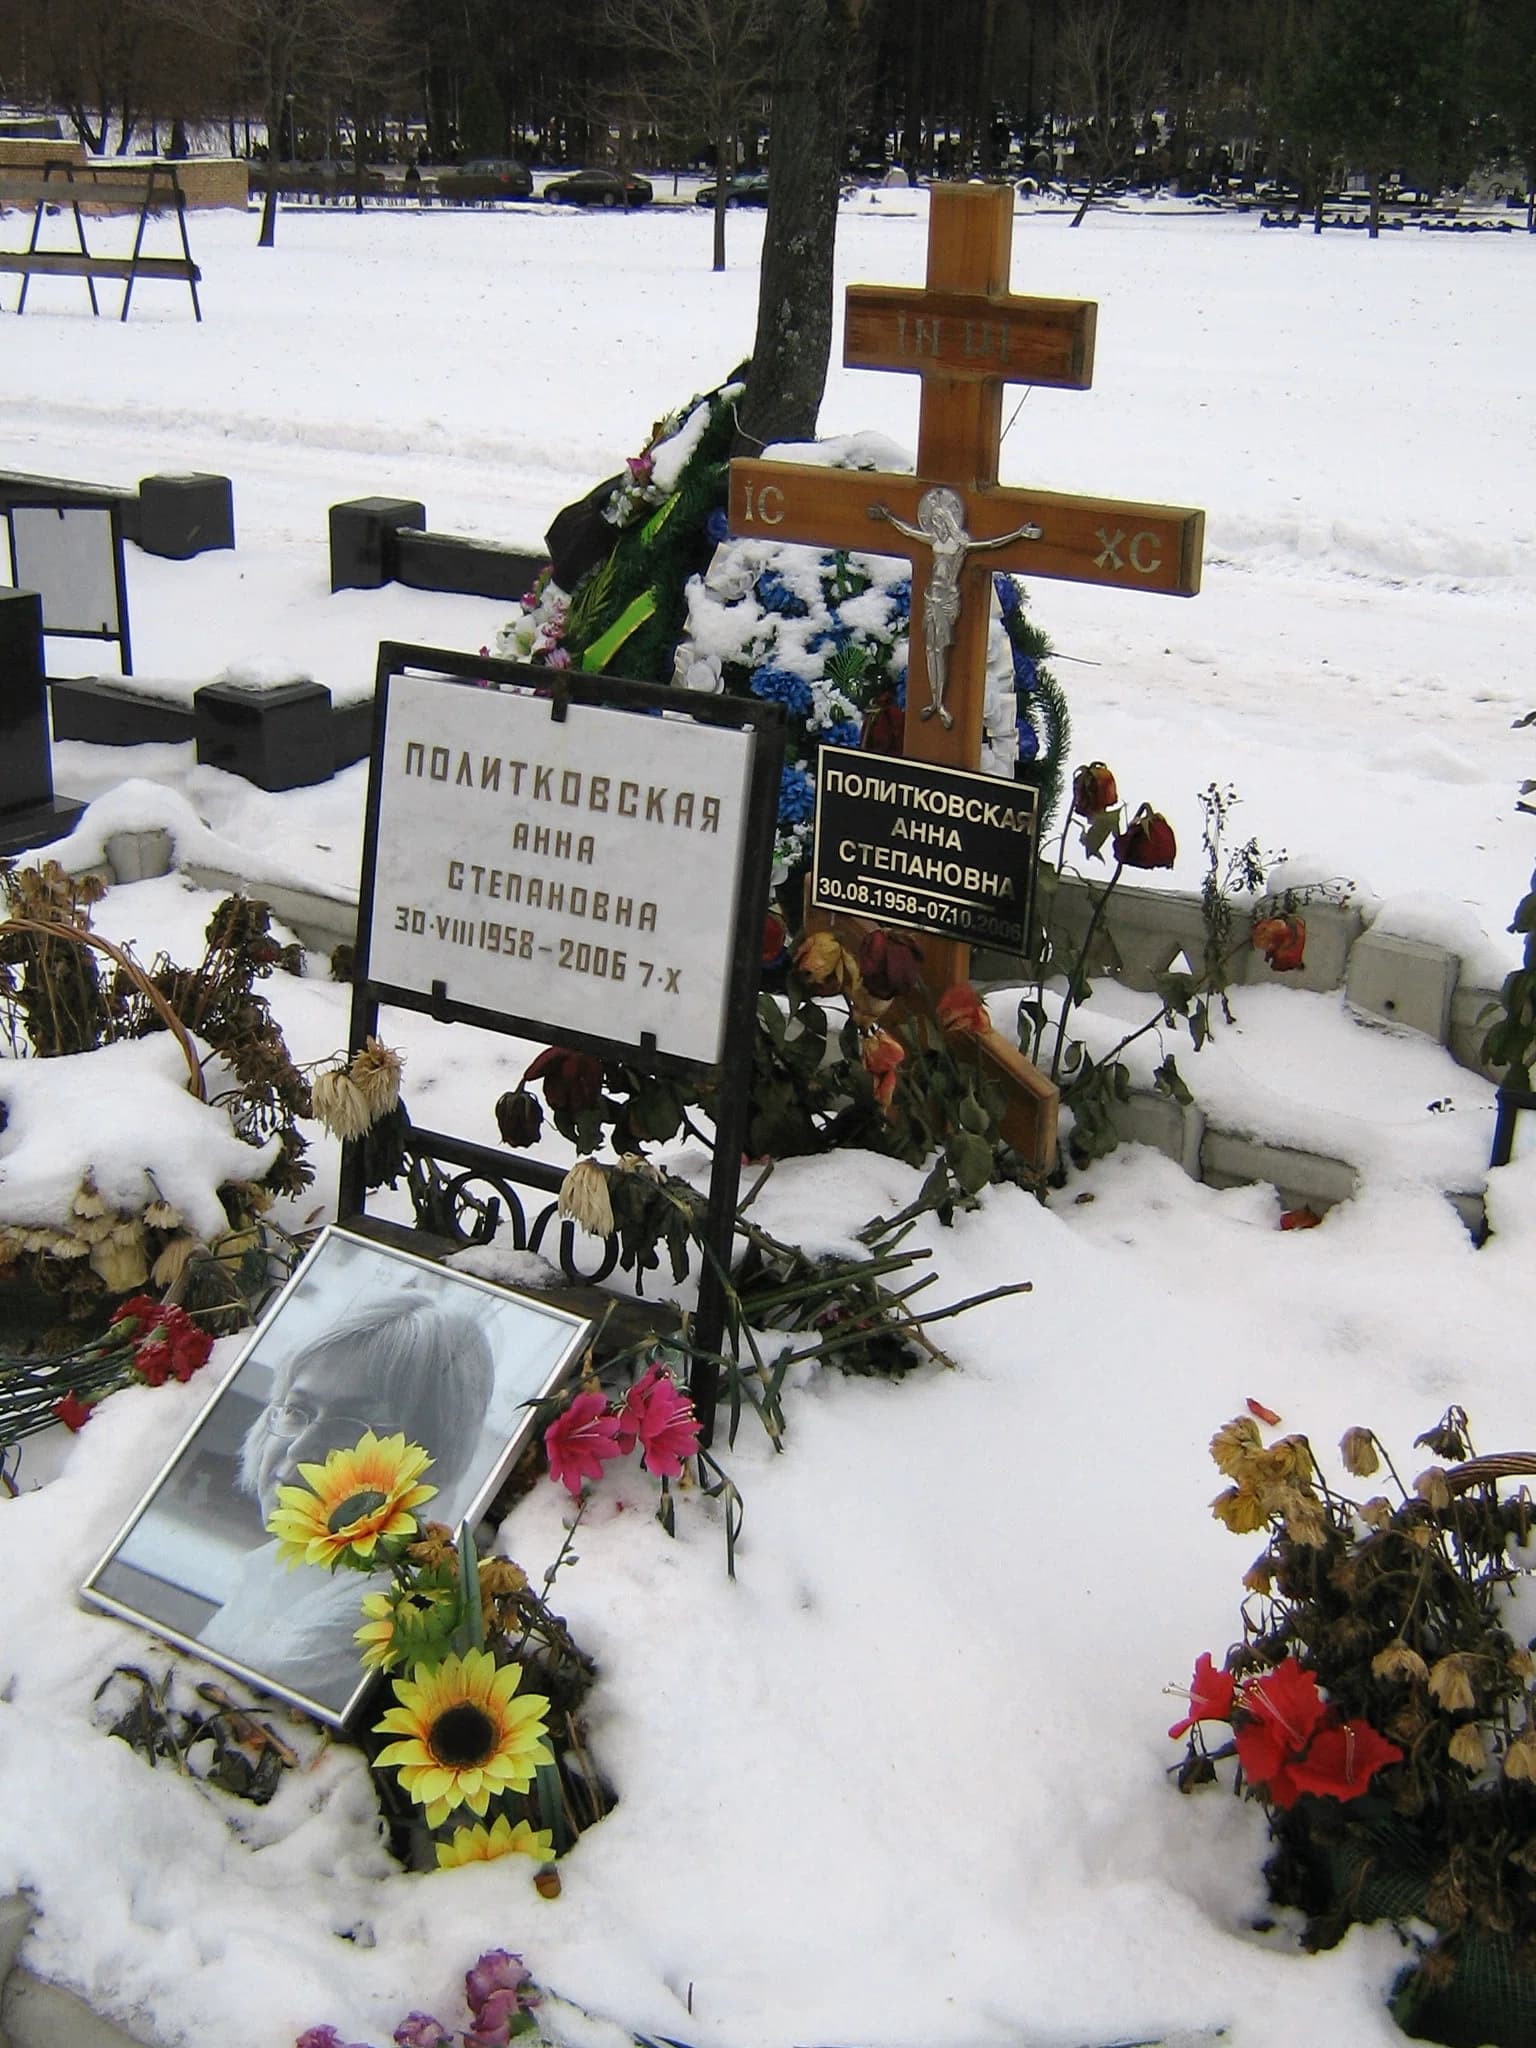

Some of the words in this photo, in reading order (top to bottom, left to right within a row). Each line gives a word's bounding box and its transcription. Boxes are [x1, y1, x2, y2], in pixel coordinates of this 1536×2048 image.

[405, 741, 721, 834] ПОЛИТКОВСКАЯ
[825, 769, 1034, 837] ПОЛИТКОВСКАЯ
[512, 822, 596, 865] АННА
[891, 817, 963, 852] АННА
[447, 860, 658, 933] СТЕПАНОВНА
[838, 839, 1016, 901] СТЕПАНОВНА
